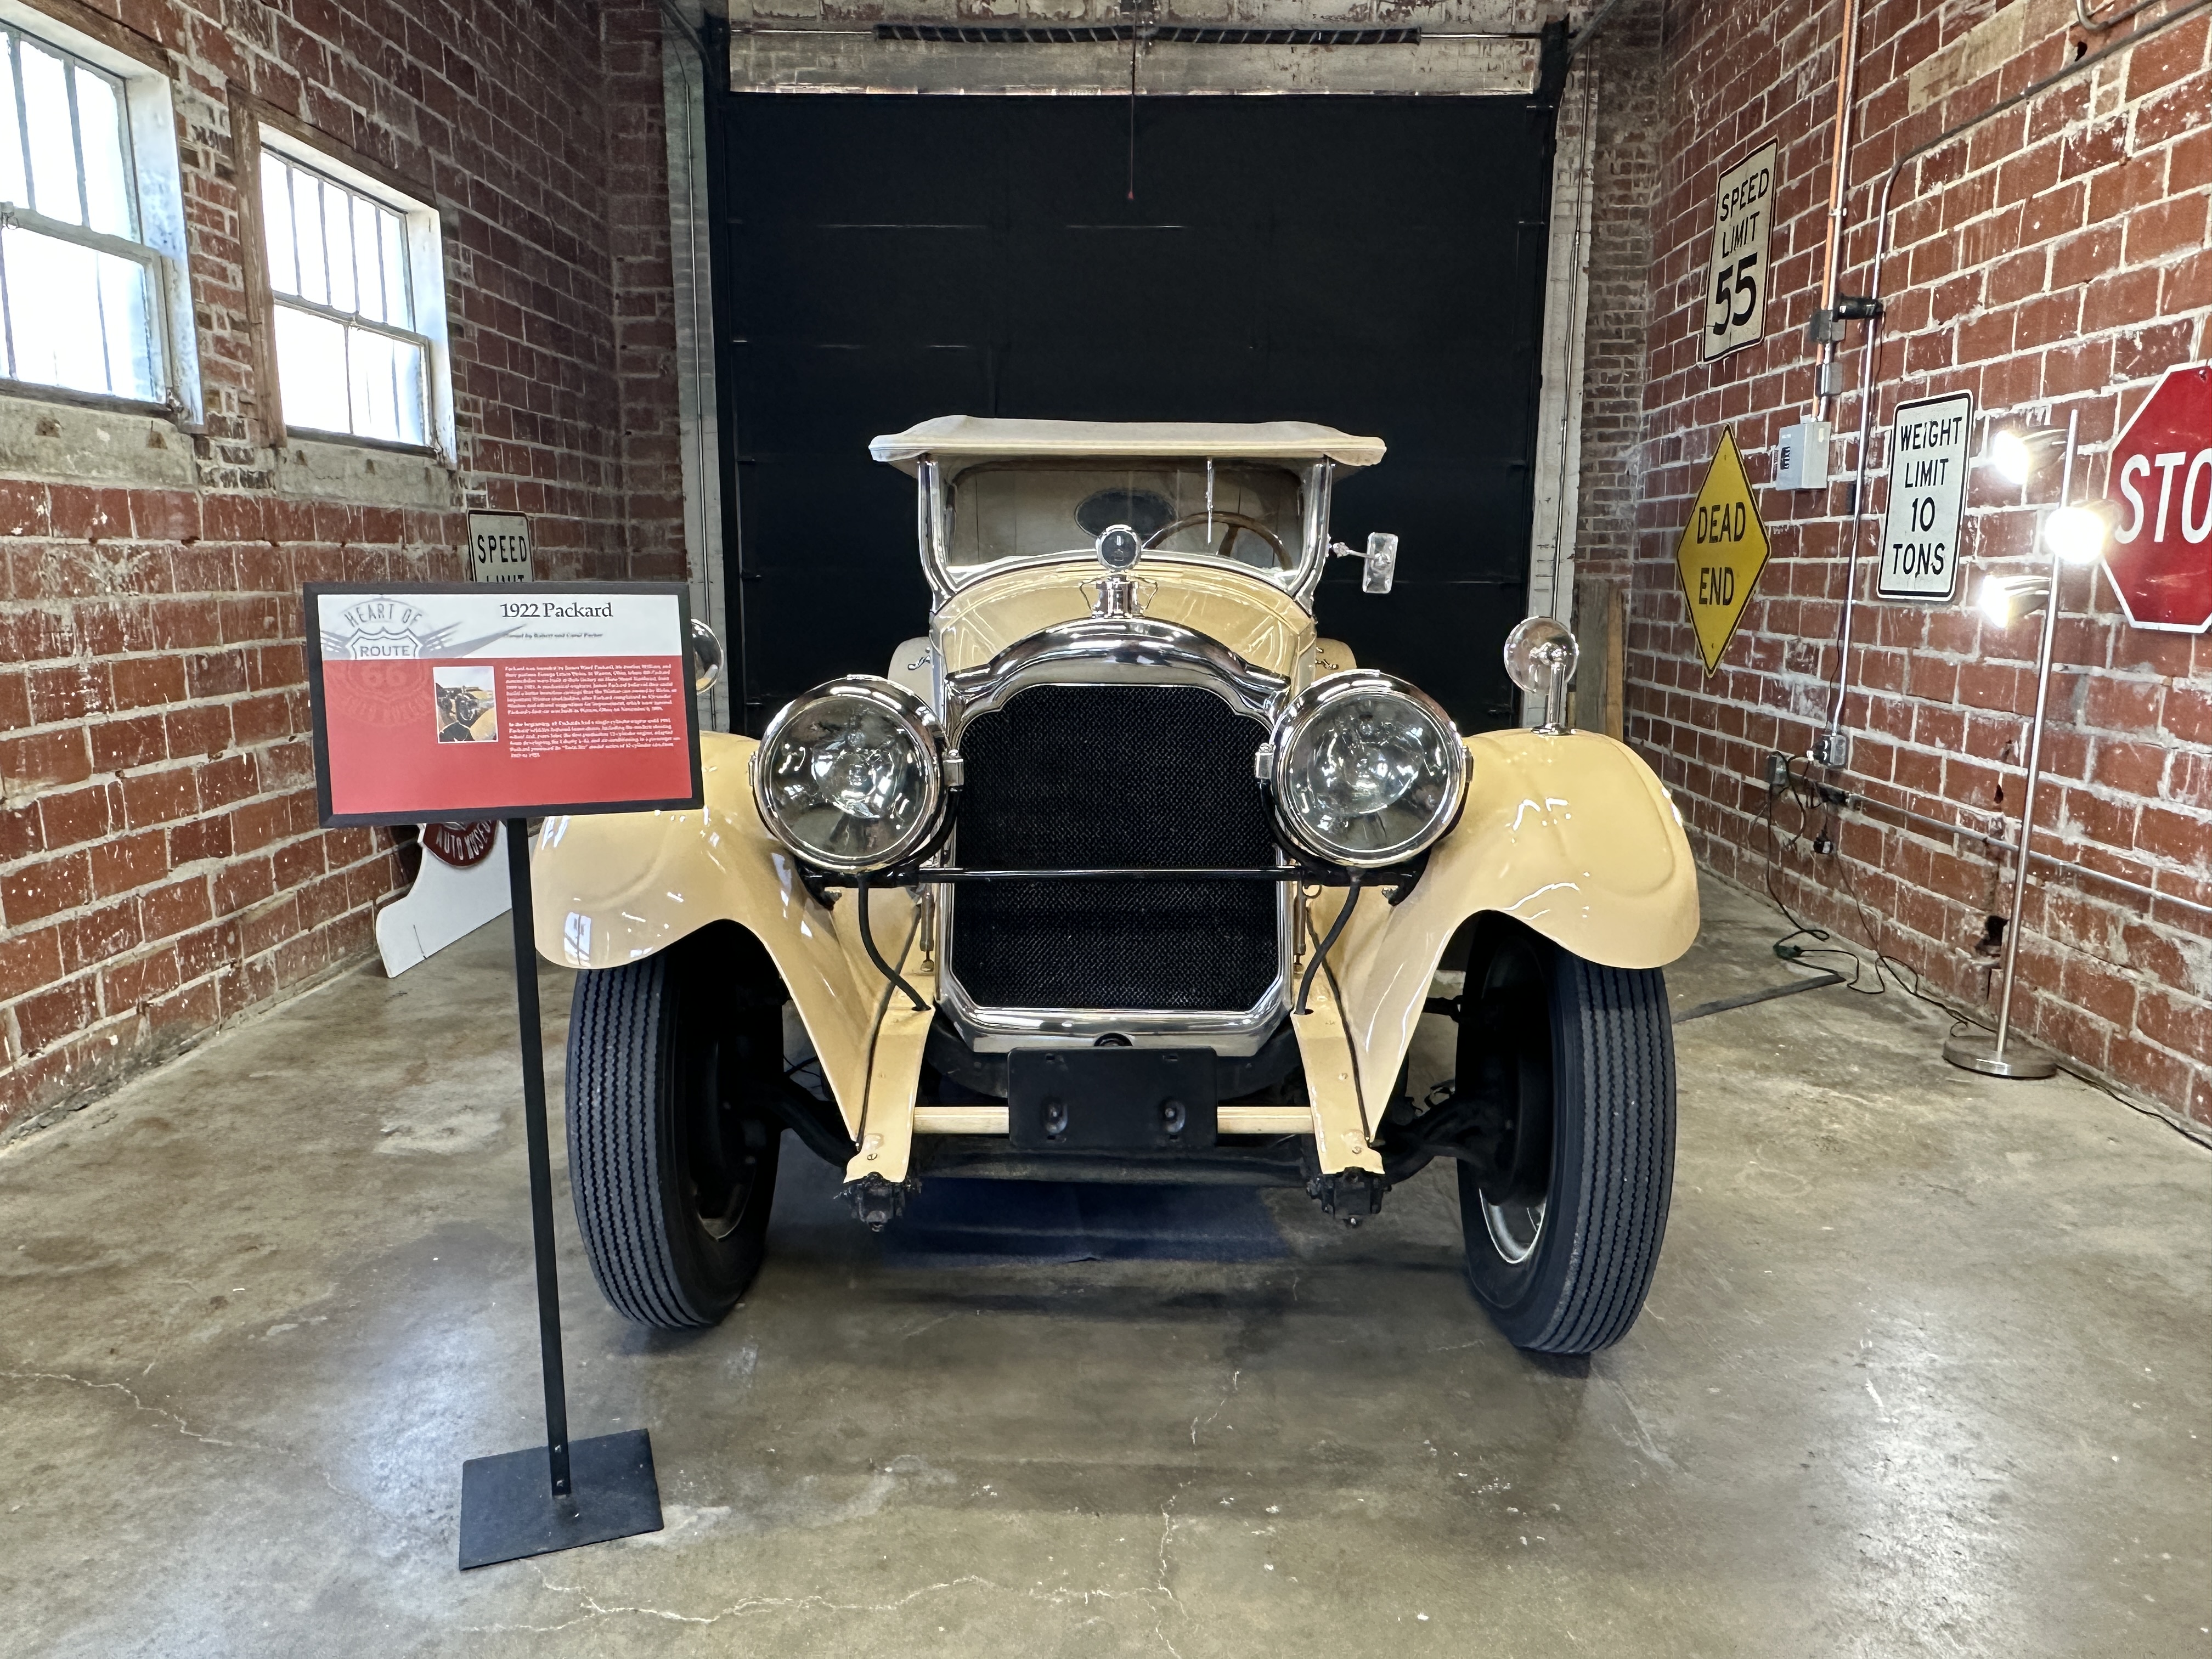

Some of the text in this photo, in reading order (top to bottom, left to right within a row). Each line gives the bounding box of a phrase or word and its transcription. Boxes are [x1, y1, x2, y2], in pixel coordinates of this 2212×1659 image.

[1720, 167, 1769, 222] SPEED
[1722, 211, 1760, 259] LIMIT
[1713, 252, 1758, 336] 55
[1900, 416, 1962, 452] WEIGHT
[1905, 458, 1949, 488] LIMIT
[1911, 496, 1936, 532] 10
[2114, 448, 2212, 544] STO
[1696, 501, 1746, 544] DEAD
[477, 534, 527, 563] SPEED
[1893, 542, 1945, 578] TONS
[1699, 567, 1735, 606] END
[344, 603, 422, 628] HEART OF
[500, 602, 614, 618] 1922 Packard
[360, 645, 410, 657] ROUTE
[436, 820, 492, 861] AUTO MUSEU
